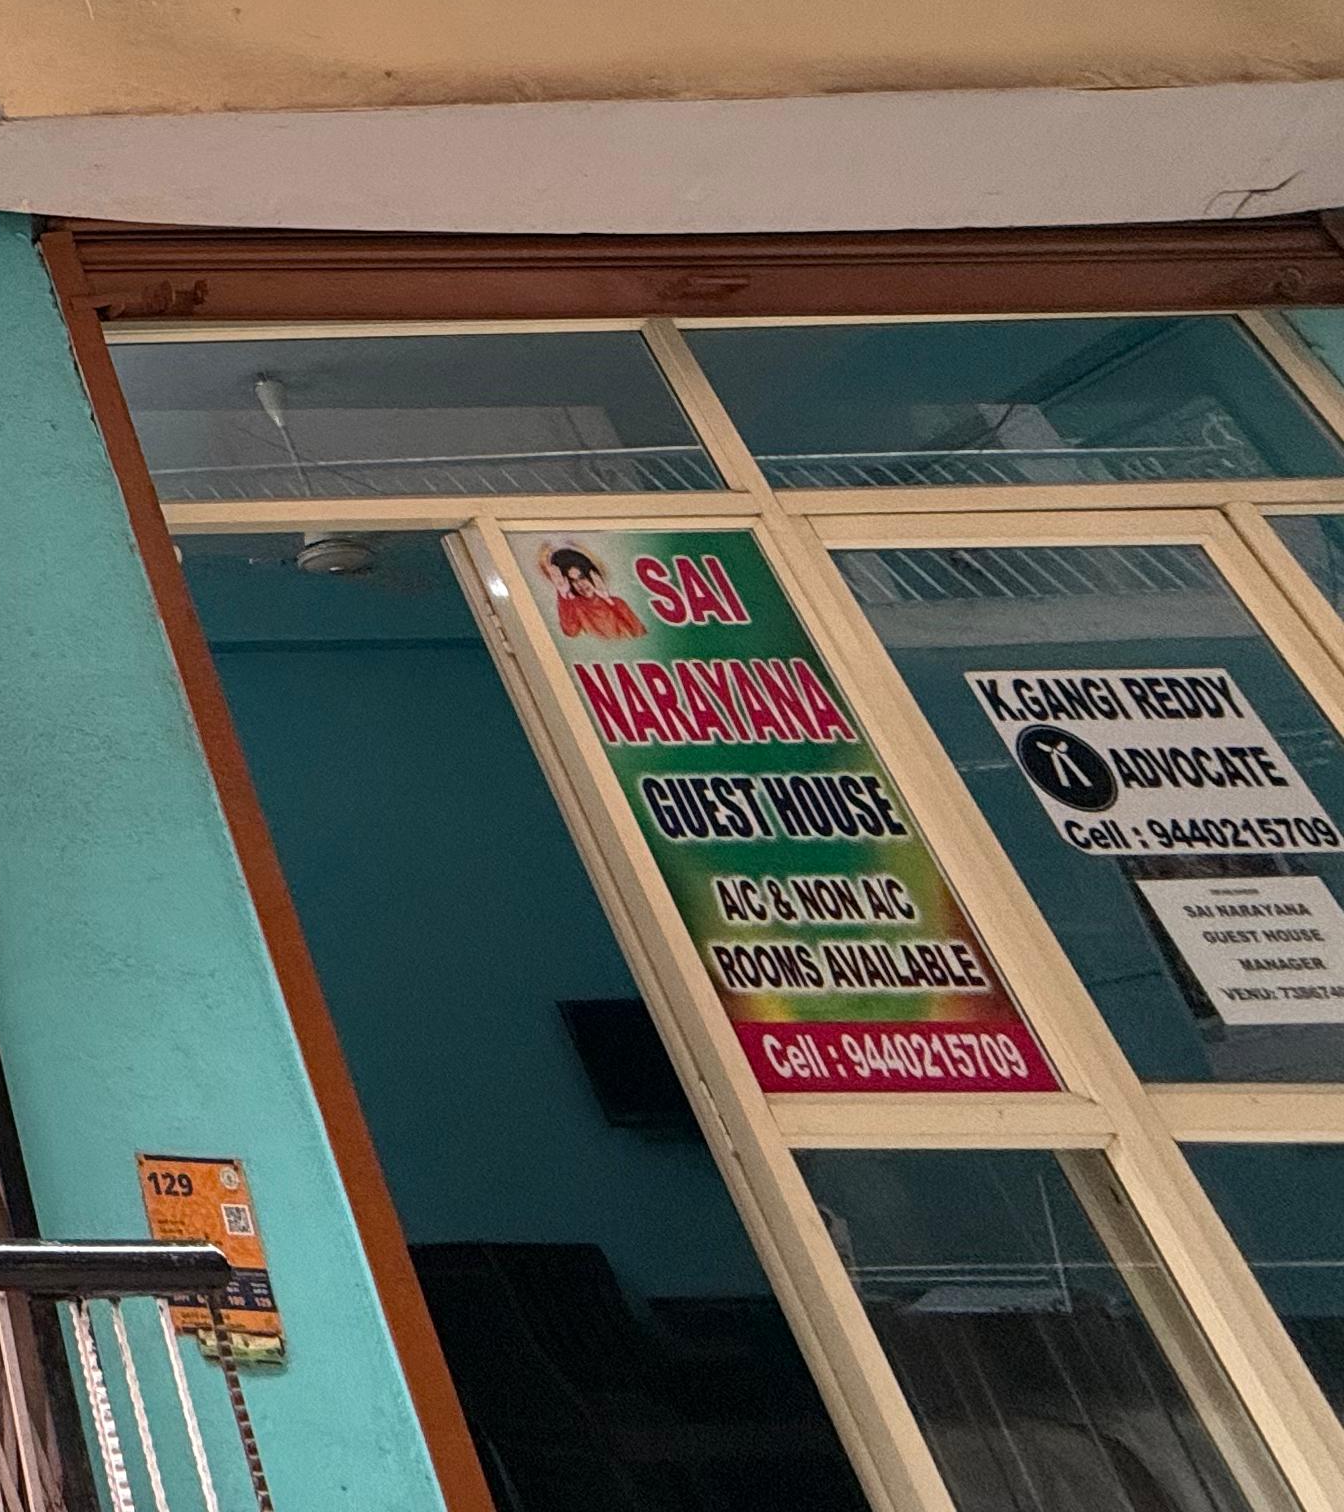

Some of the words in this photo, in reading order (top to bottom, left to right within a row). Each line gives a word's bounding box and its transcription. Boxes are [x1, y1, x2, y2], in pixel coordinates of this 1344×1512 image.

[635, 556, 750, 624] SAI
[574, 660, 857, 742] NARAYANA
[976, 678, 1131, 720] K.GANGI
[1119, 676, 1244, 719] REDDY
[1109, 746, 1289, 788] ADVOCATE
[643, 777, 774, 837] GUEST
[761, 775, 907, 836] HOUSE
[1064, 819, 1131, 849] Cell
[1147, 817, 1339, 849] 9440215709
[716, 879, 766, 921] A/C
[768, 880, 798, 920] &
[791, 879, 865, 920] NON
[862, 879, 915, 920] A/C
[1183, 905, 1216, 919] SAI
[1216, 903, 1312, 918] NARAYANA
[1202, 930, 1259, 944] GUEST
[1262, 928, 1326, 942] HOUSE
[712, 945, 824, 988] ROOMS
[823, 944, 986, 987] AVAILABLE
[1237, 957, 1327, 971] MANAGER
[763, 1034, 829, 1079] Cell
[842, 1033, 1029, 1079] 9440215709
[147, 1172, 194, 1198] 129
